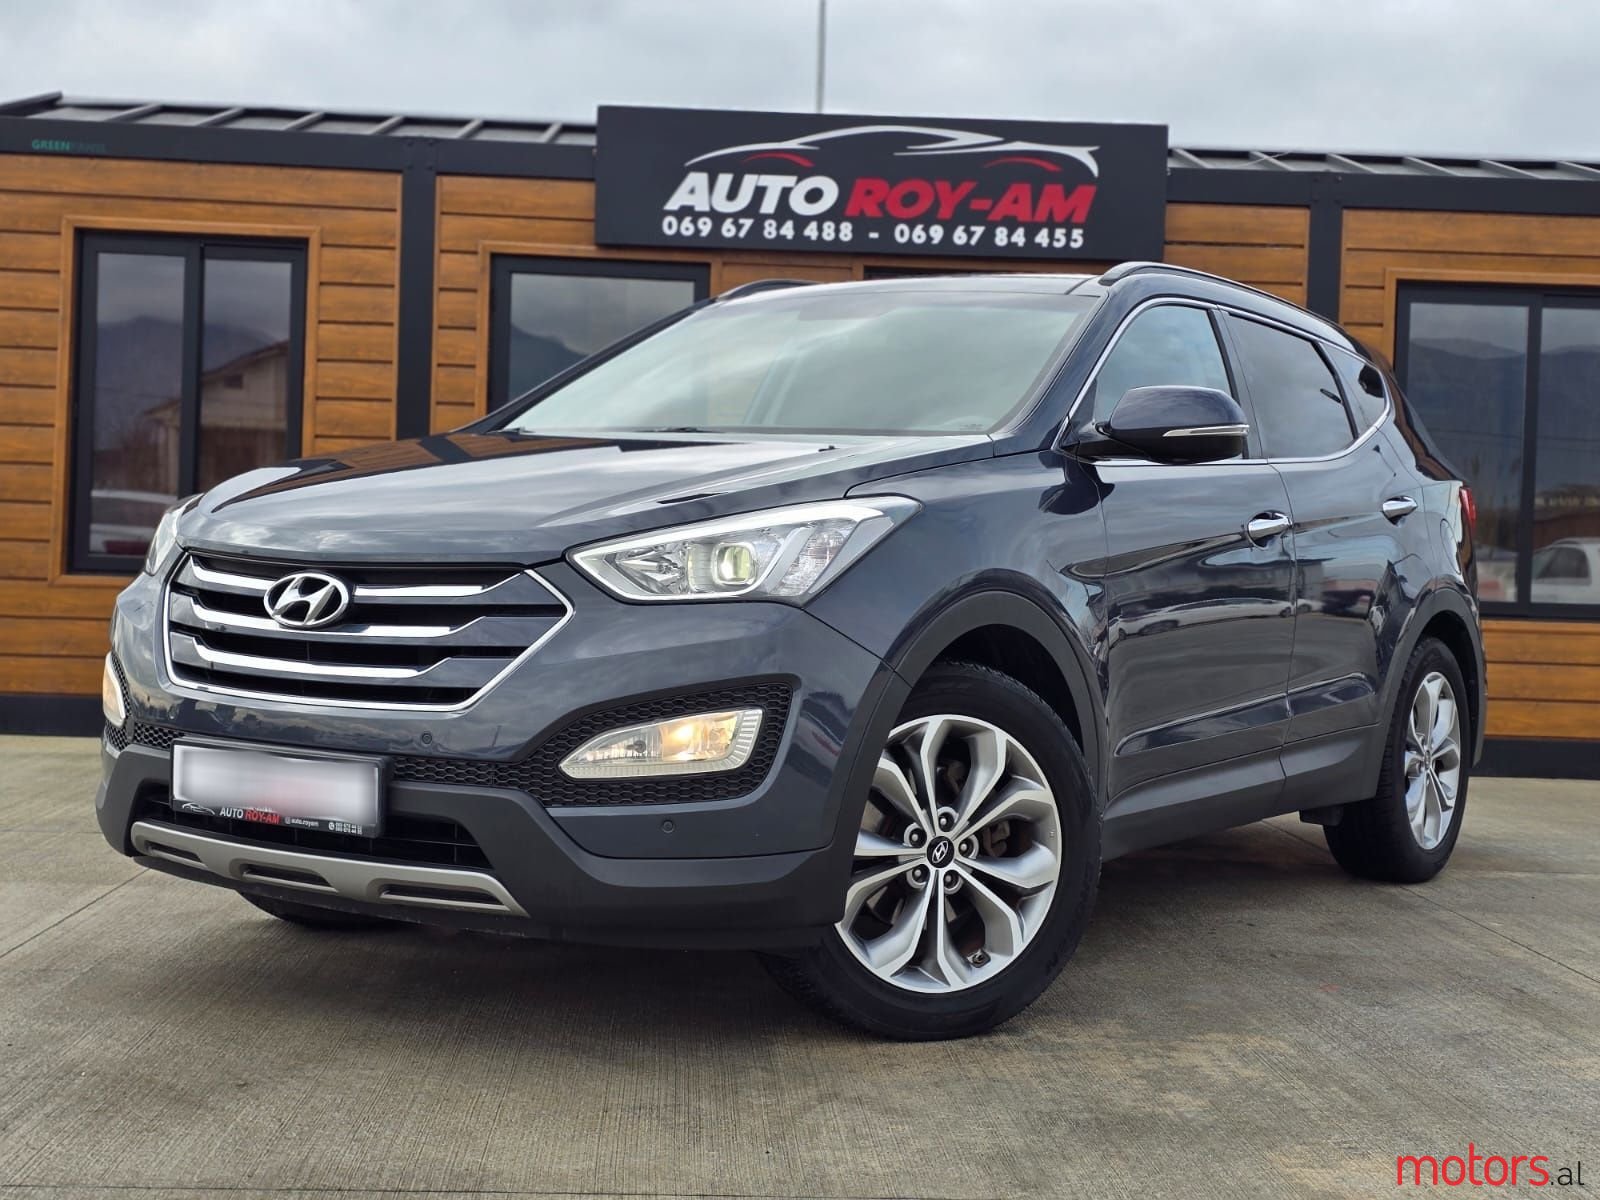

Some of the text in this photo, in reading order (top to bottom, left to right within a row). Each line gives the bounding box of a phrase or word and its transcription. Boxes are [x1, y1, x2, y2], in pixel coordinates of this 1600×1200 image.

[663, 171, 1096, 224] AUTO ROY-AM
[662, 215, 713, 237] 069
[721, 217, 754, 238] 67
[763, 219, 795, 240] 84
[803, 219, 853, 242] 488
[894, 223, 944, 245] 069
[952, 225, 986, 246] 67
[994, 226, 1026, 247] 84
[1034, 227, 1084, 249] 455
[219, 807, 244, 819] AUTO
[245, 808, 281, 825] ROY-AM
